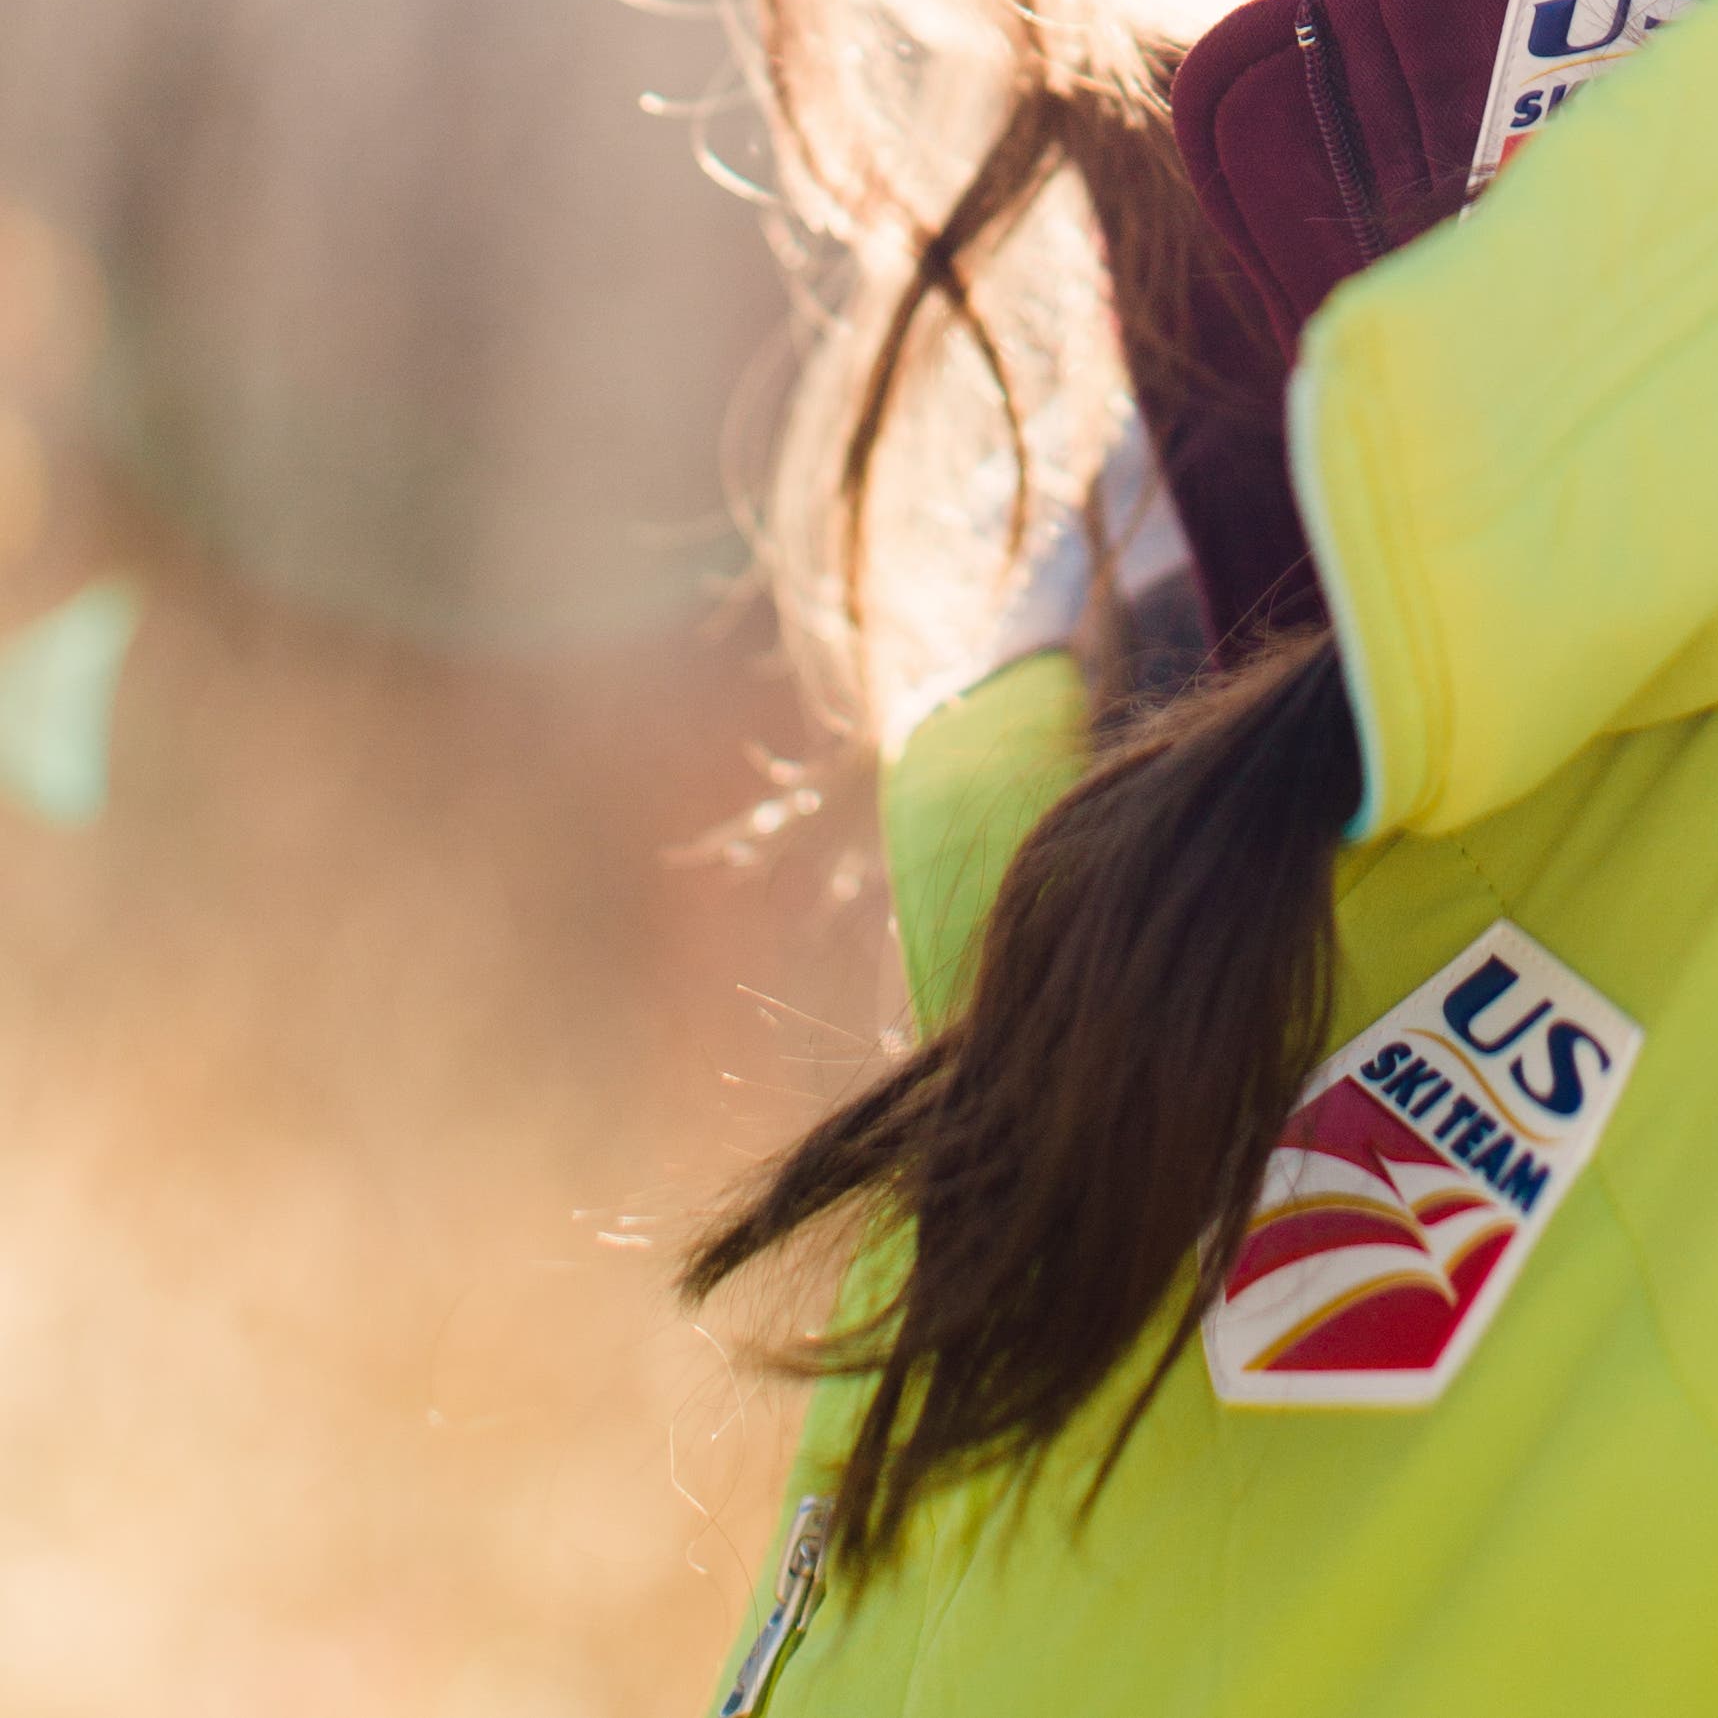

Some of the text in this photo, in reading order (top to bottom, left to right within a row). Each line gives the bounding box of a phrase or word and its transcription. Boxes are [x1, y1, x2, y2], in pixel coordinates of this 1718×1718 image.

[1442, 953, 1612, 1120] US
[1359, 1041, 1551, 1217] SKI TEAM
